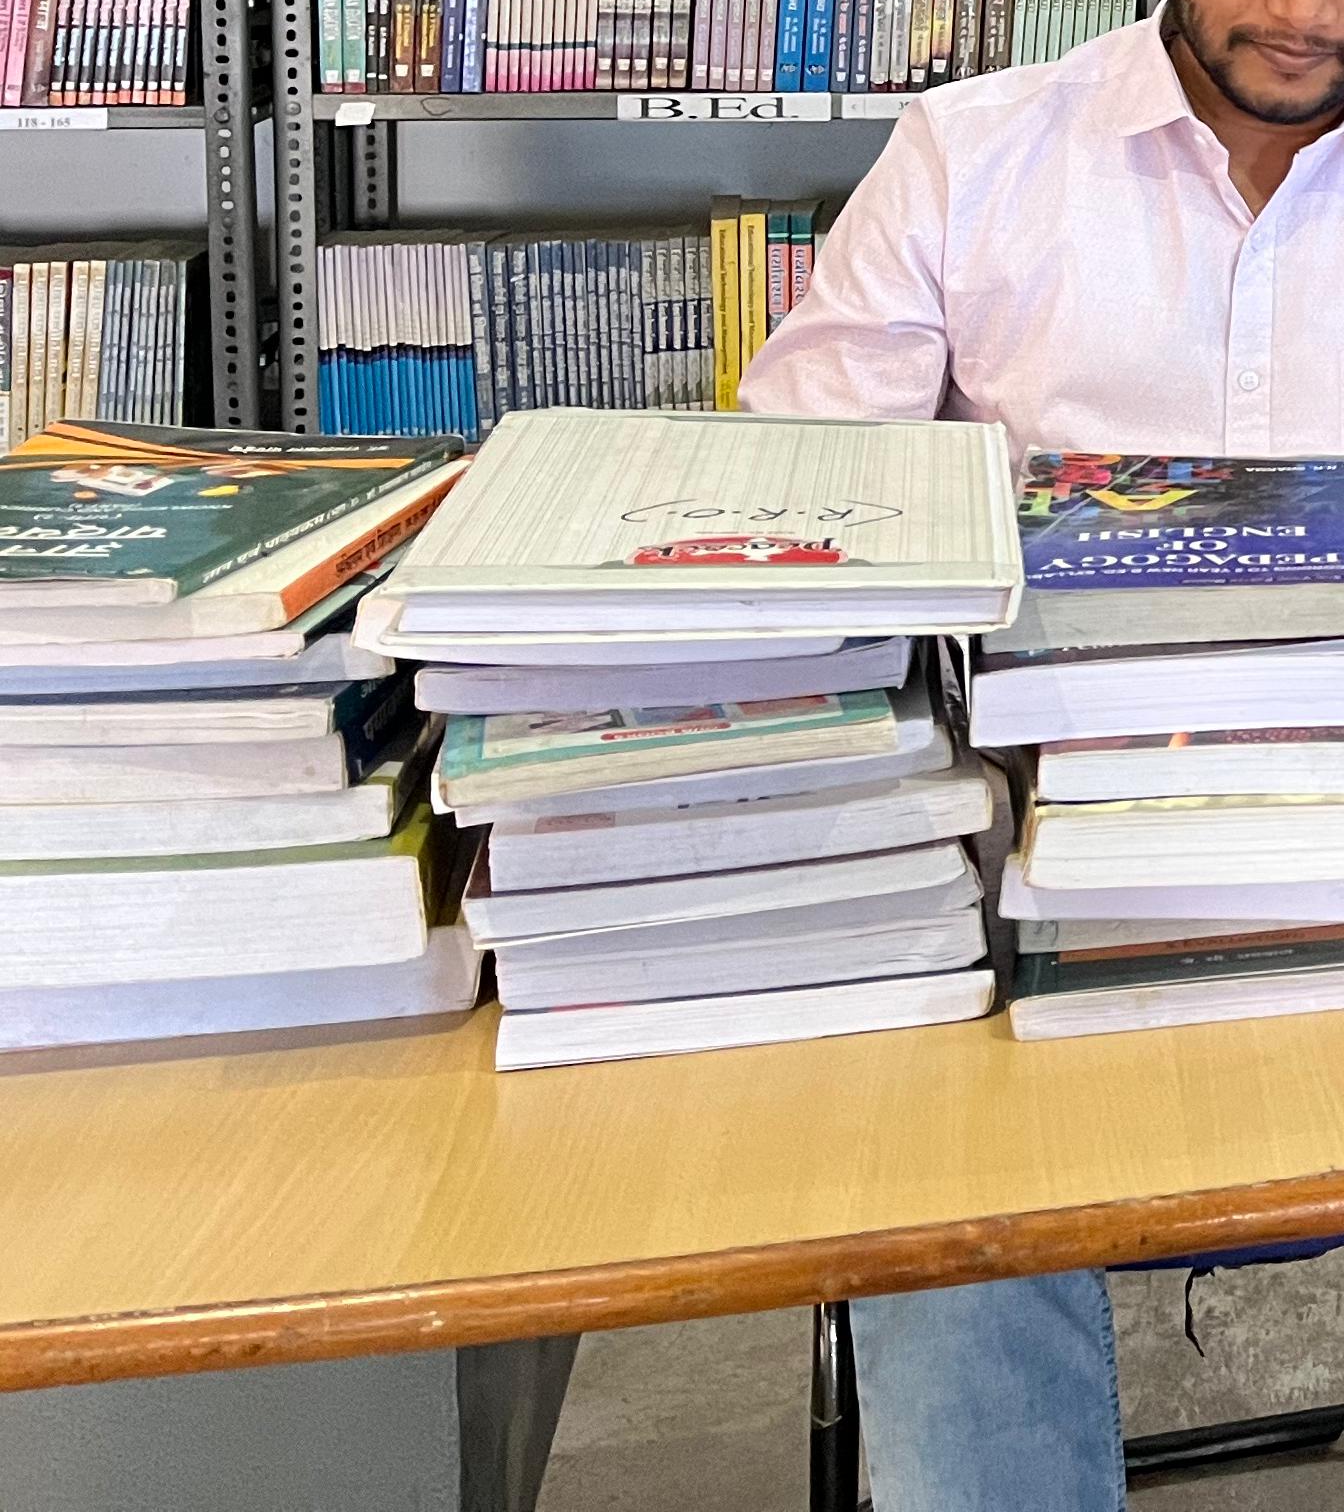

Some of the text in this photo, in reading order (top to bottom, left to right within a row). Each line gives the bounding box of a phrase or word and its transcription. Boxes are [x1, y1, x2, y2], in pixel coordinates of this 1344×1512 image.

[640, 98, 799, 120] B.Ed.
[17, 117, 71, 129] 118 165
[1076, 524, 1308, 542] ENGLISH
[1153, 539, 1229, 552] OF
[1037, 551, 1341, 571] PEDAGOGY
